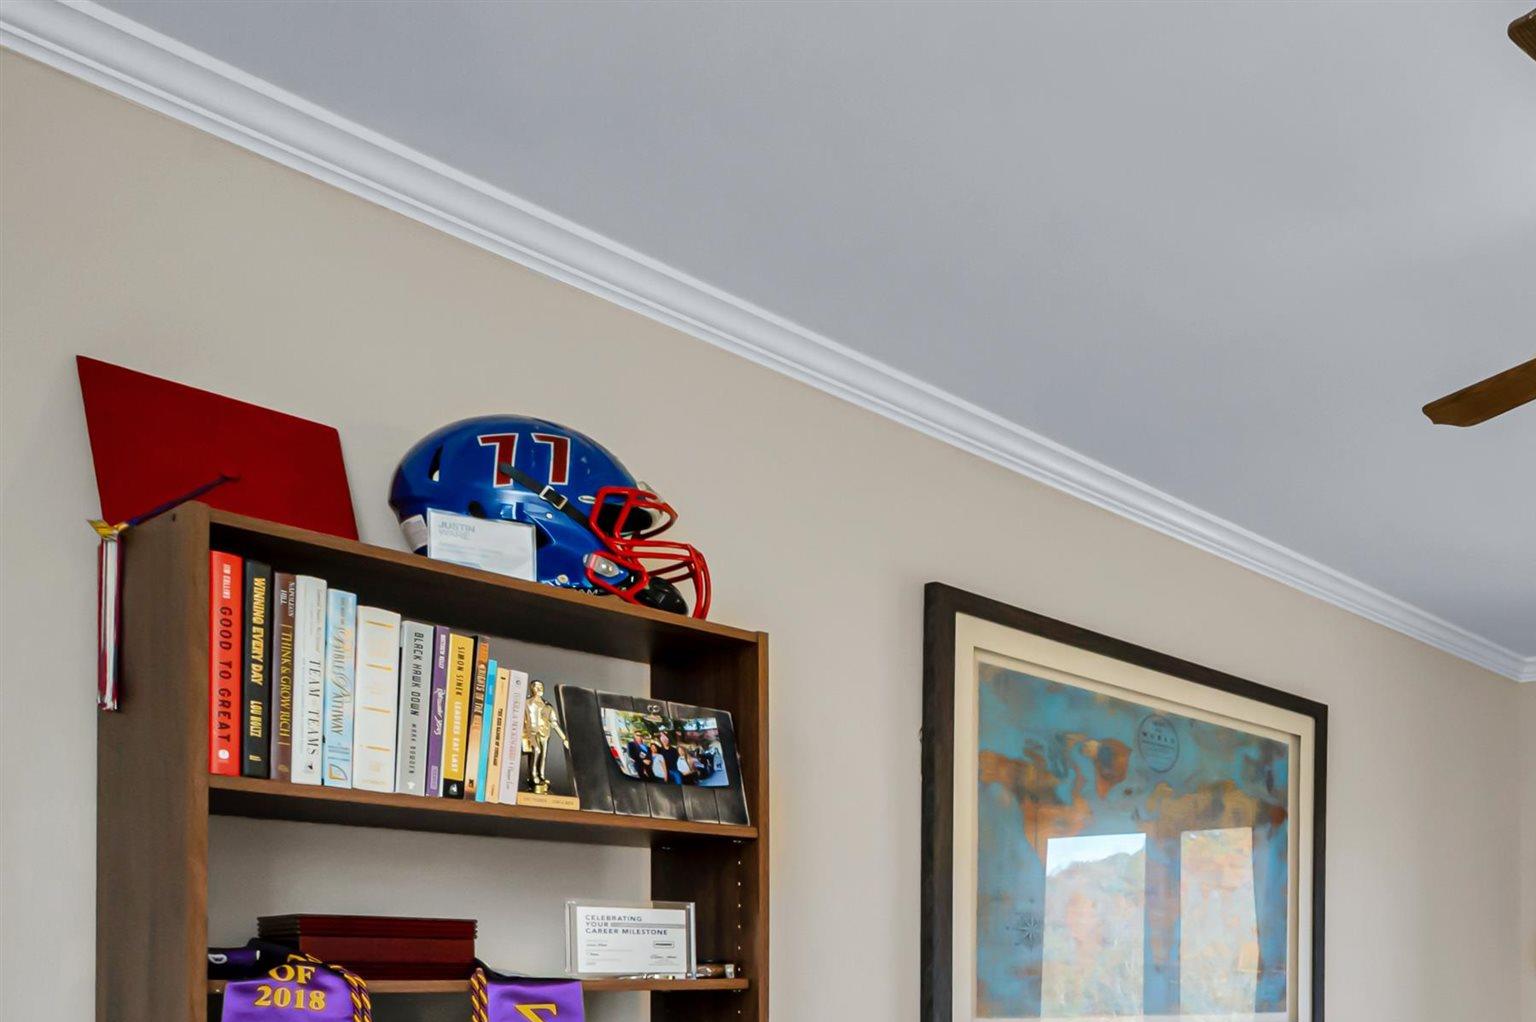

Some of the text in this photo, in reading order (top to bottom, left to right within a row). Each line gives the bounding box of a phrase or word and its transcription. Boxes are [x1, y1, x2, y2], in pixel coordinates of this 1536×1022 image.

[477, 432, 571, 488] 77
[280, 589, 288, 605] HILL
[288, 581, 296, 618] NAPOLEON
[250, 577, 266, 686] WINNING EVERY DAY
[217, 606, 233, 742] GOOD TO GREAT
[279, 633, 293, 737] THINK & GROW RICH
[308, 660, 321, 697] TEAM
[410, 632, 424, 716] BLACK HAWK DOWN
[455, 646, 465, 696] SIMON SINEK
[249, 700, 263, 738] LOU HOLTZ
[331, 672, 351, 736] PATHWAY
[307, 710, 320, 755] TEAMS
[451, 701, 462, 772] LEADERS EAT LAST
[584, 914, 643, 922] CELEBRATING
[584, 927, 668, 936] CAREER MILESTONE
[268, 964, 316, 984] OF
[254, 984, 327, 1011] 2018
